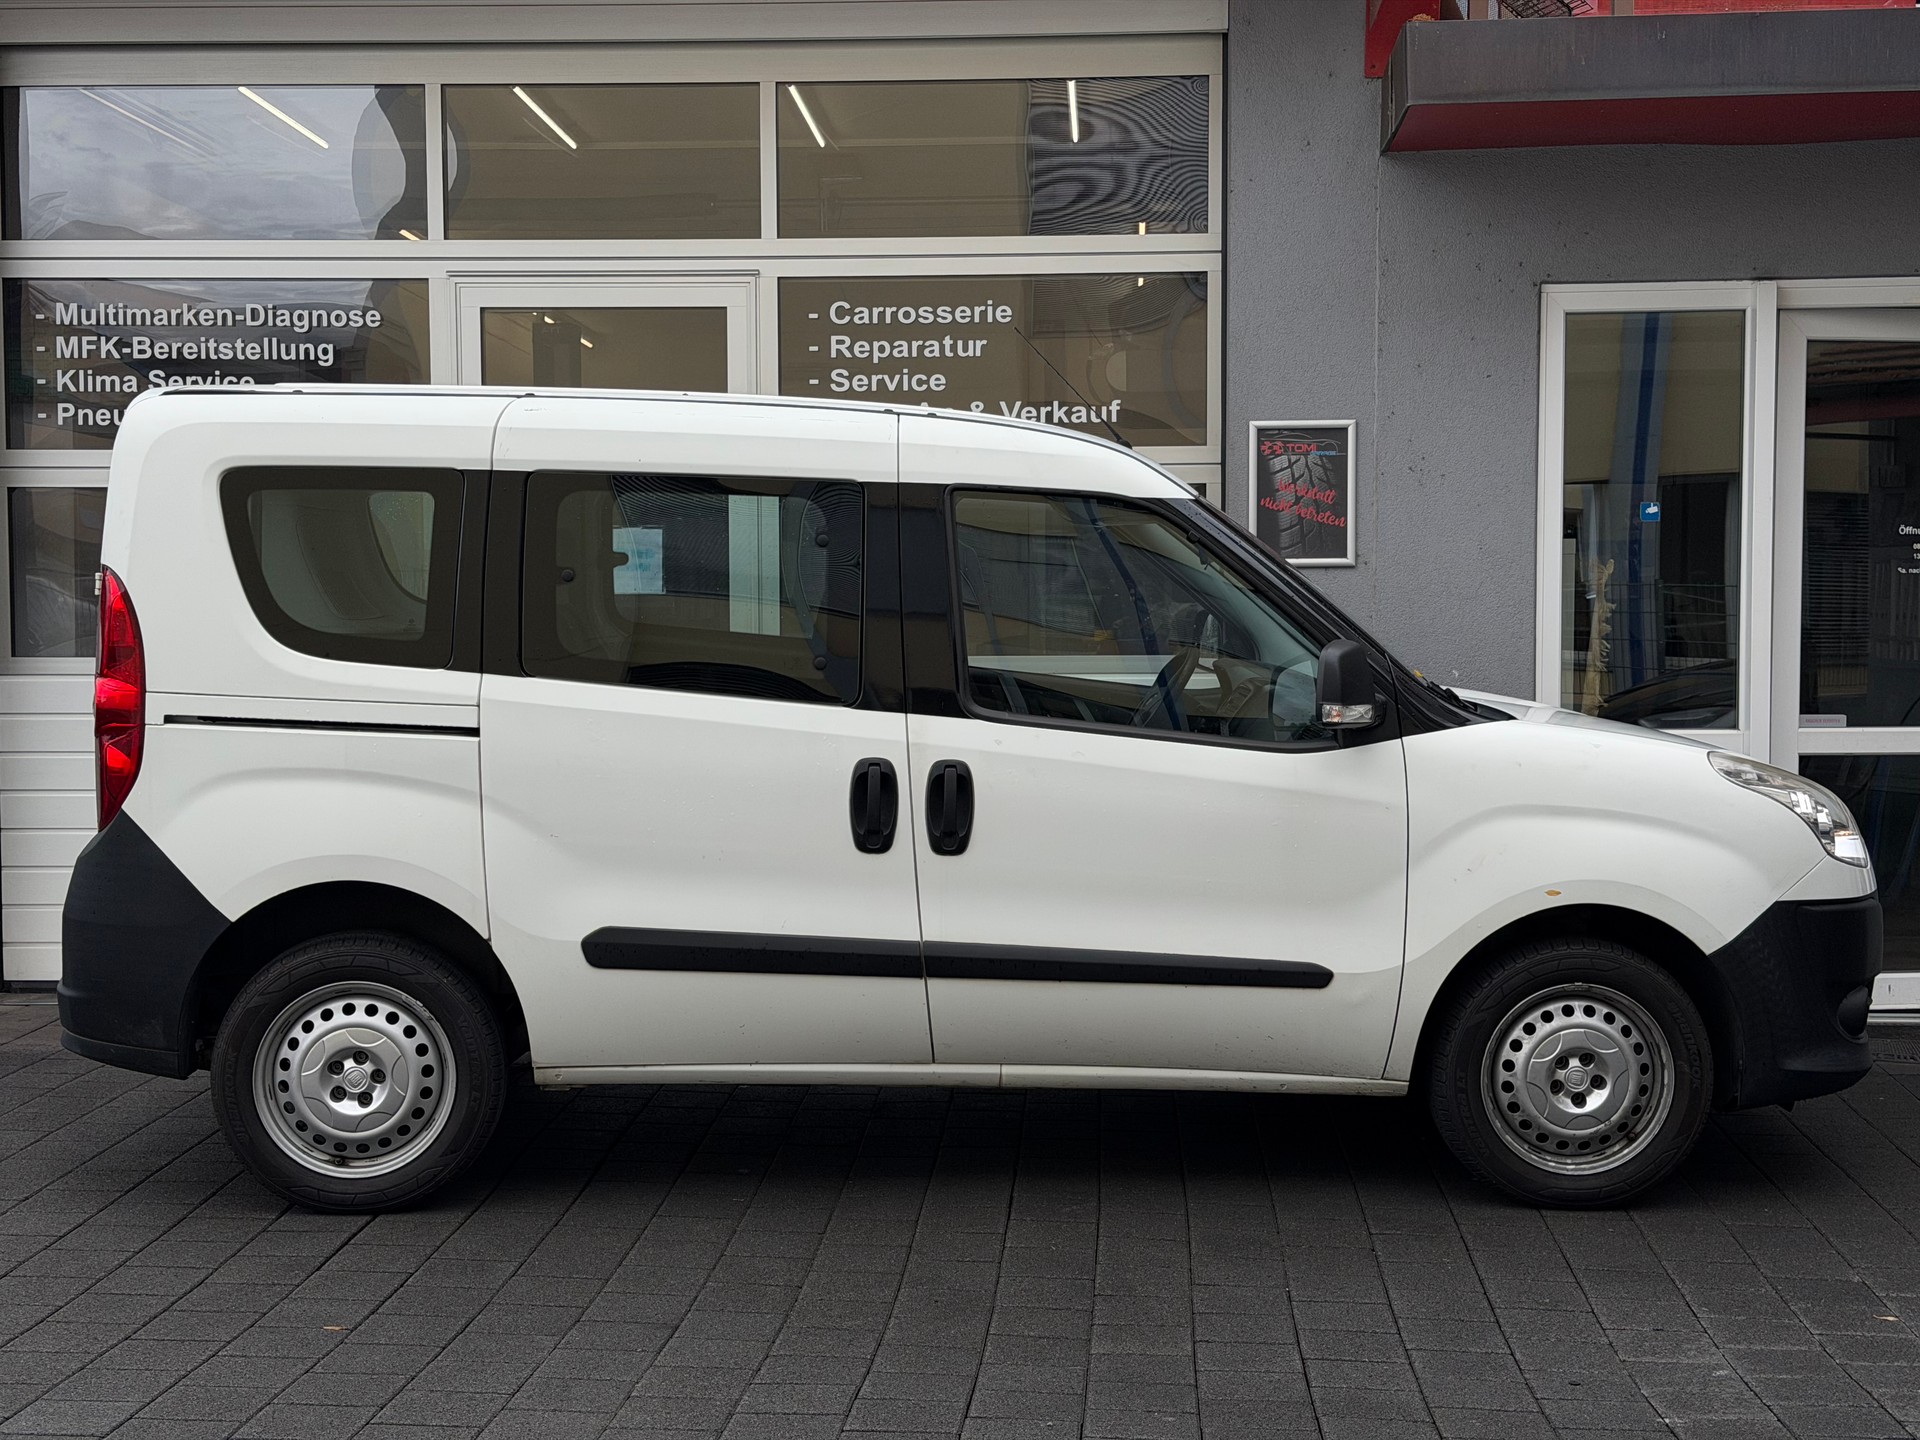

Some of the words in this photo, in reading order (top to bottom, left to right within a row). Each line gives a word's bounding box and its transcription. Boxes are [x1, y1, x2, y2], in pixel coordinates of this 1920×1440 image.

[54, 302, 382, 332] Multimarken-Diagnose
[829, 300, 1013, 324] Carrosserie
[55, 336, 335, 366] MFK-Bereitstellung
[830, 335, 988, 363] Reparatur
[56, 369, 138, 393] Klima
[830, 368, 947, 392] Service
[1000, 400, 1121, 424] Verkauf
[1287, 443, 1317, 452] TOMI
[1260, 496, 1294, 512] nicht
[1296, 504, 1346, 527] betreten
